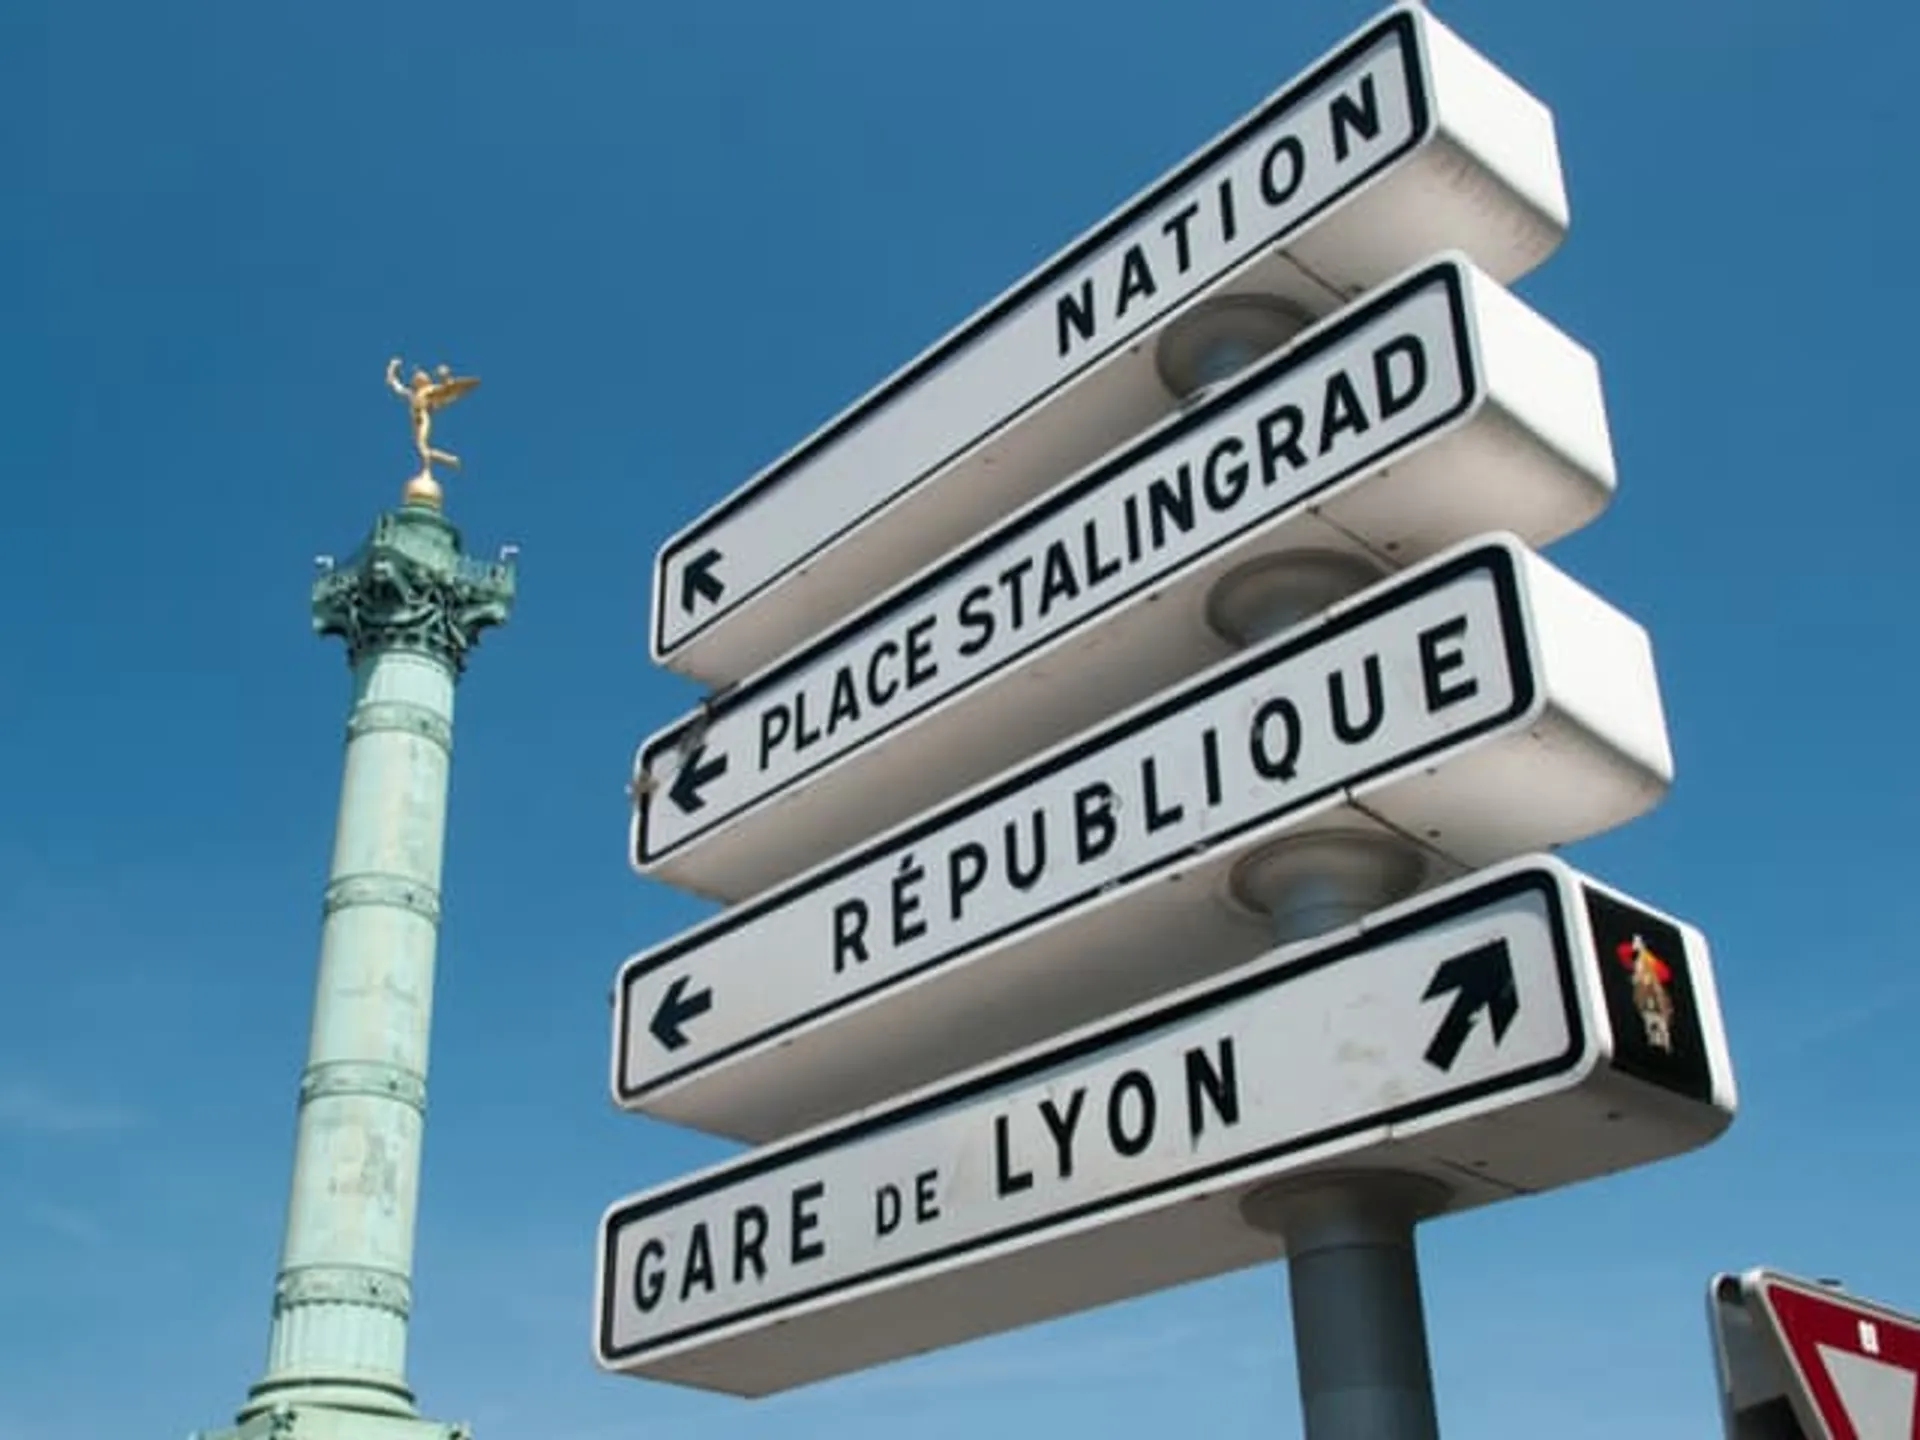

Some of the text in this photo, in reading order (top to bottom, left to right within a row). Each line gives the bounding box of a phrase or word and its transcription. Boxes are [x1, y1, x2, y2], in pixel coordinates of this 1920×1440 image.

[1056, 72, 1381, 357] NATION
[759, 333, 1427, 771] PLACE STALINGRAD
[833, 615, 1478, 974] RÉPUBLIQUE
[633, 1036, 1240, 1314] GARE DE LYON
